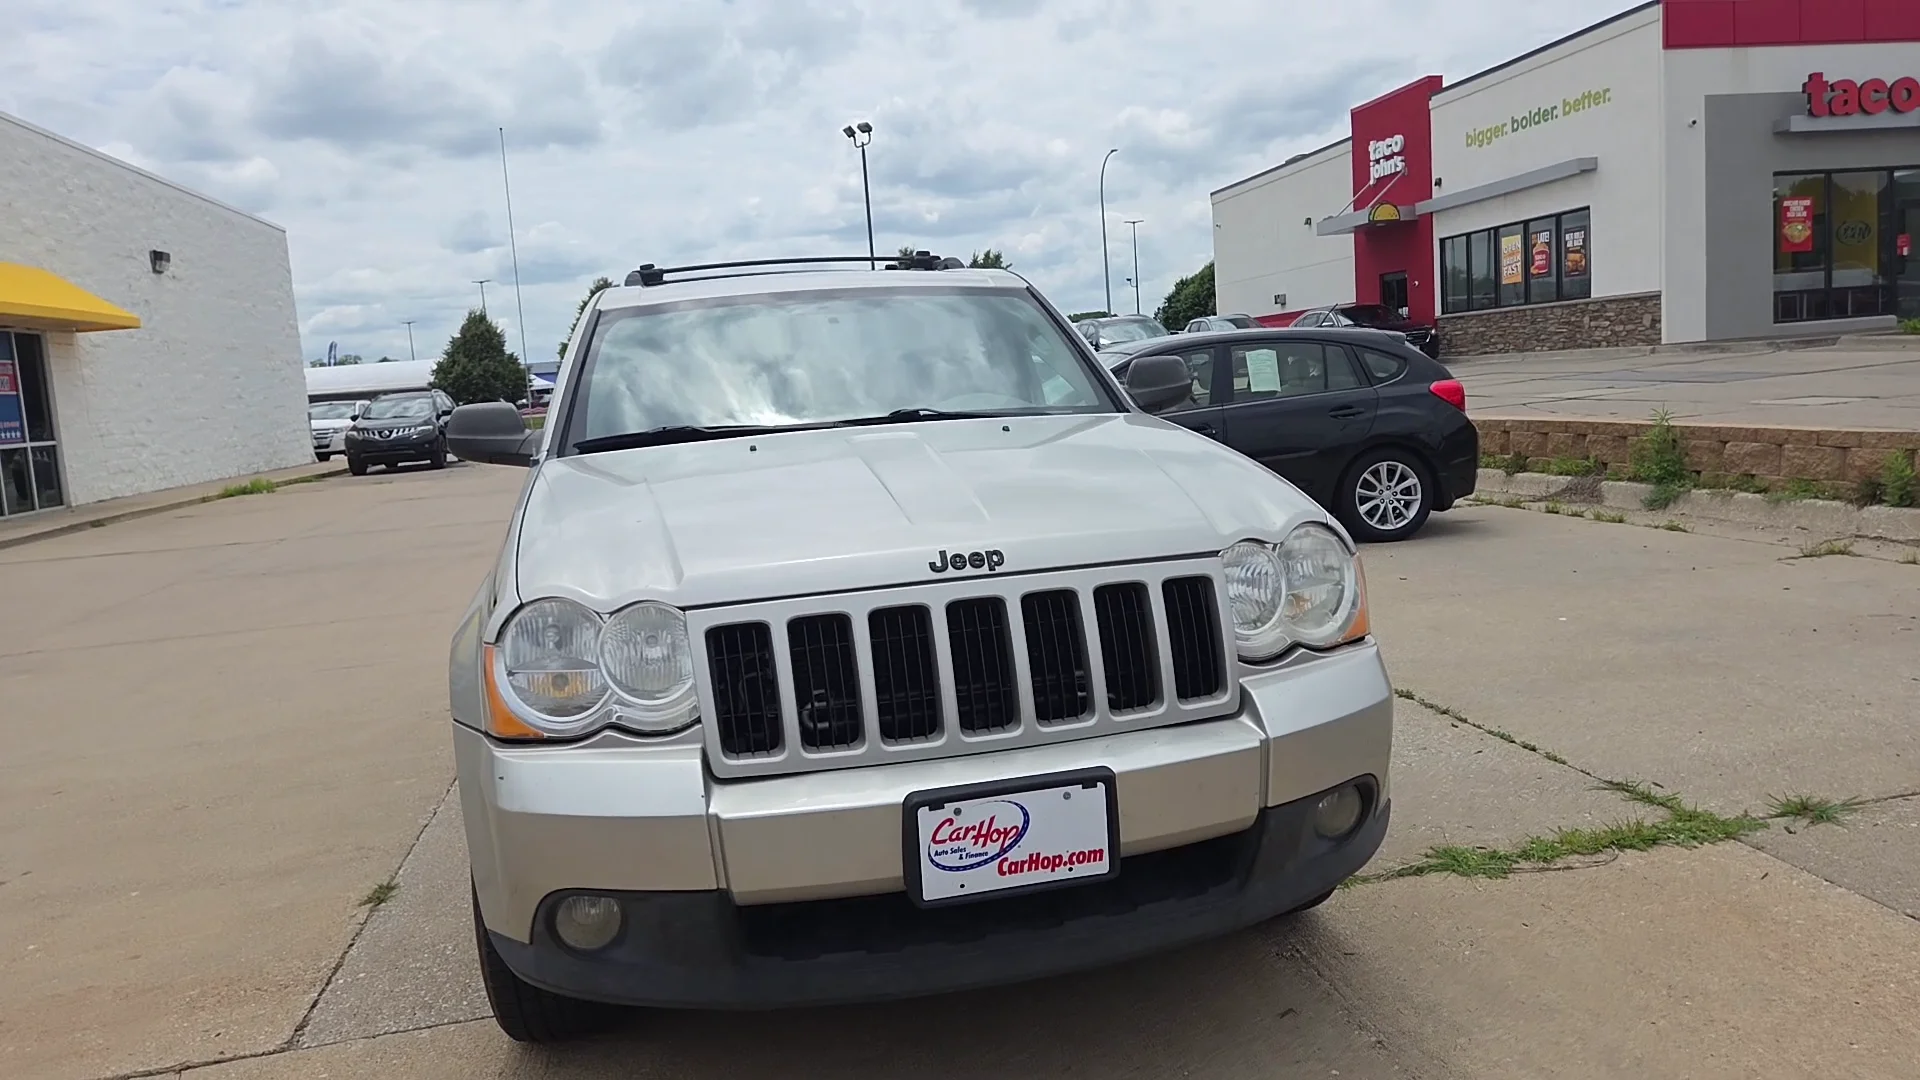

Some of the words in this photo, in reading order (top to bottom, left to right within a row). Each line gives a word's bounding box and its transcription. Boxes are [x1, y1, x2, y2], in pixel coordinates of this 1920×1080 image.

[1803, 72, 1920, 117] taco
[1465, 122, 1508, 148] bigger.
[1511, 105, 1558, 134] bolder.
[1562, 87, 1612, 117] better.
[1369, 134, 1405, 160] taco
[1369, 156, 1405, 185] john's
[928, 549, 1005, 573] Jeep
[930, 815, 1020, 852] CarHop
[934, 849, 949, 858] Auto
[950, 846, 967, 855] Sales
[958, 851, 964, 860] &
[965, 850, 989, 860] Finance
[997, 848, 1104, 877] CarHop.com
